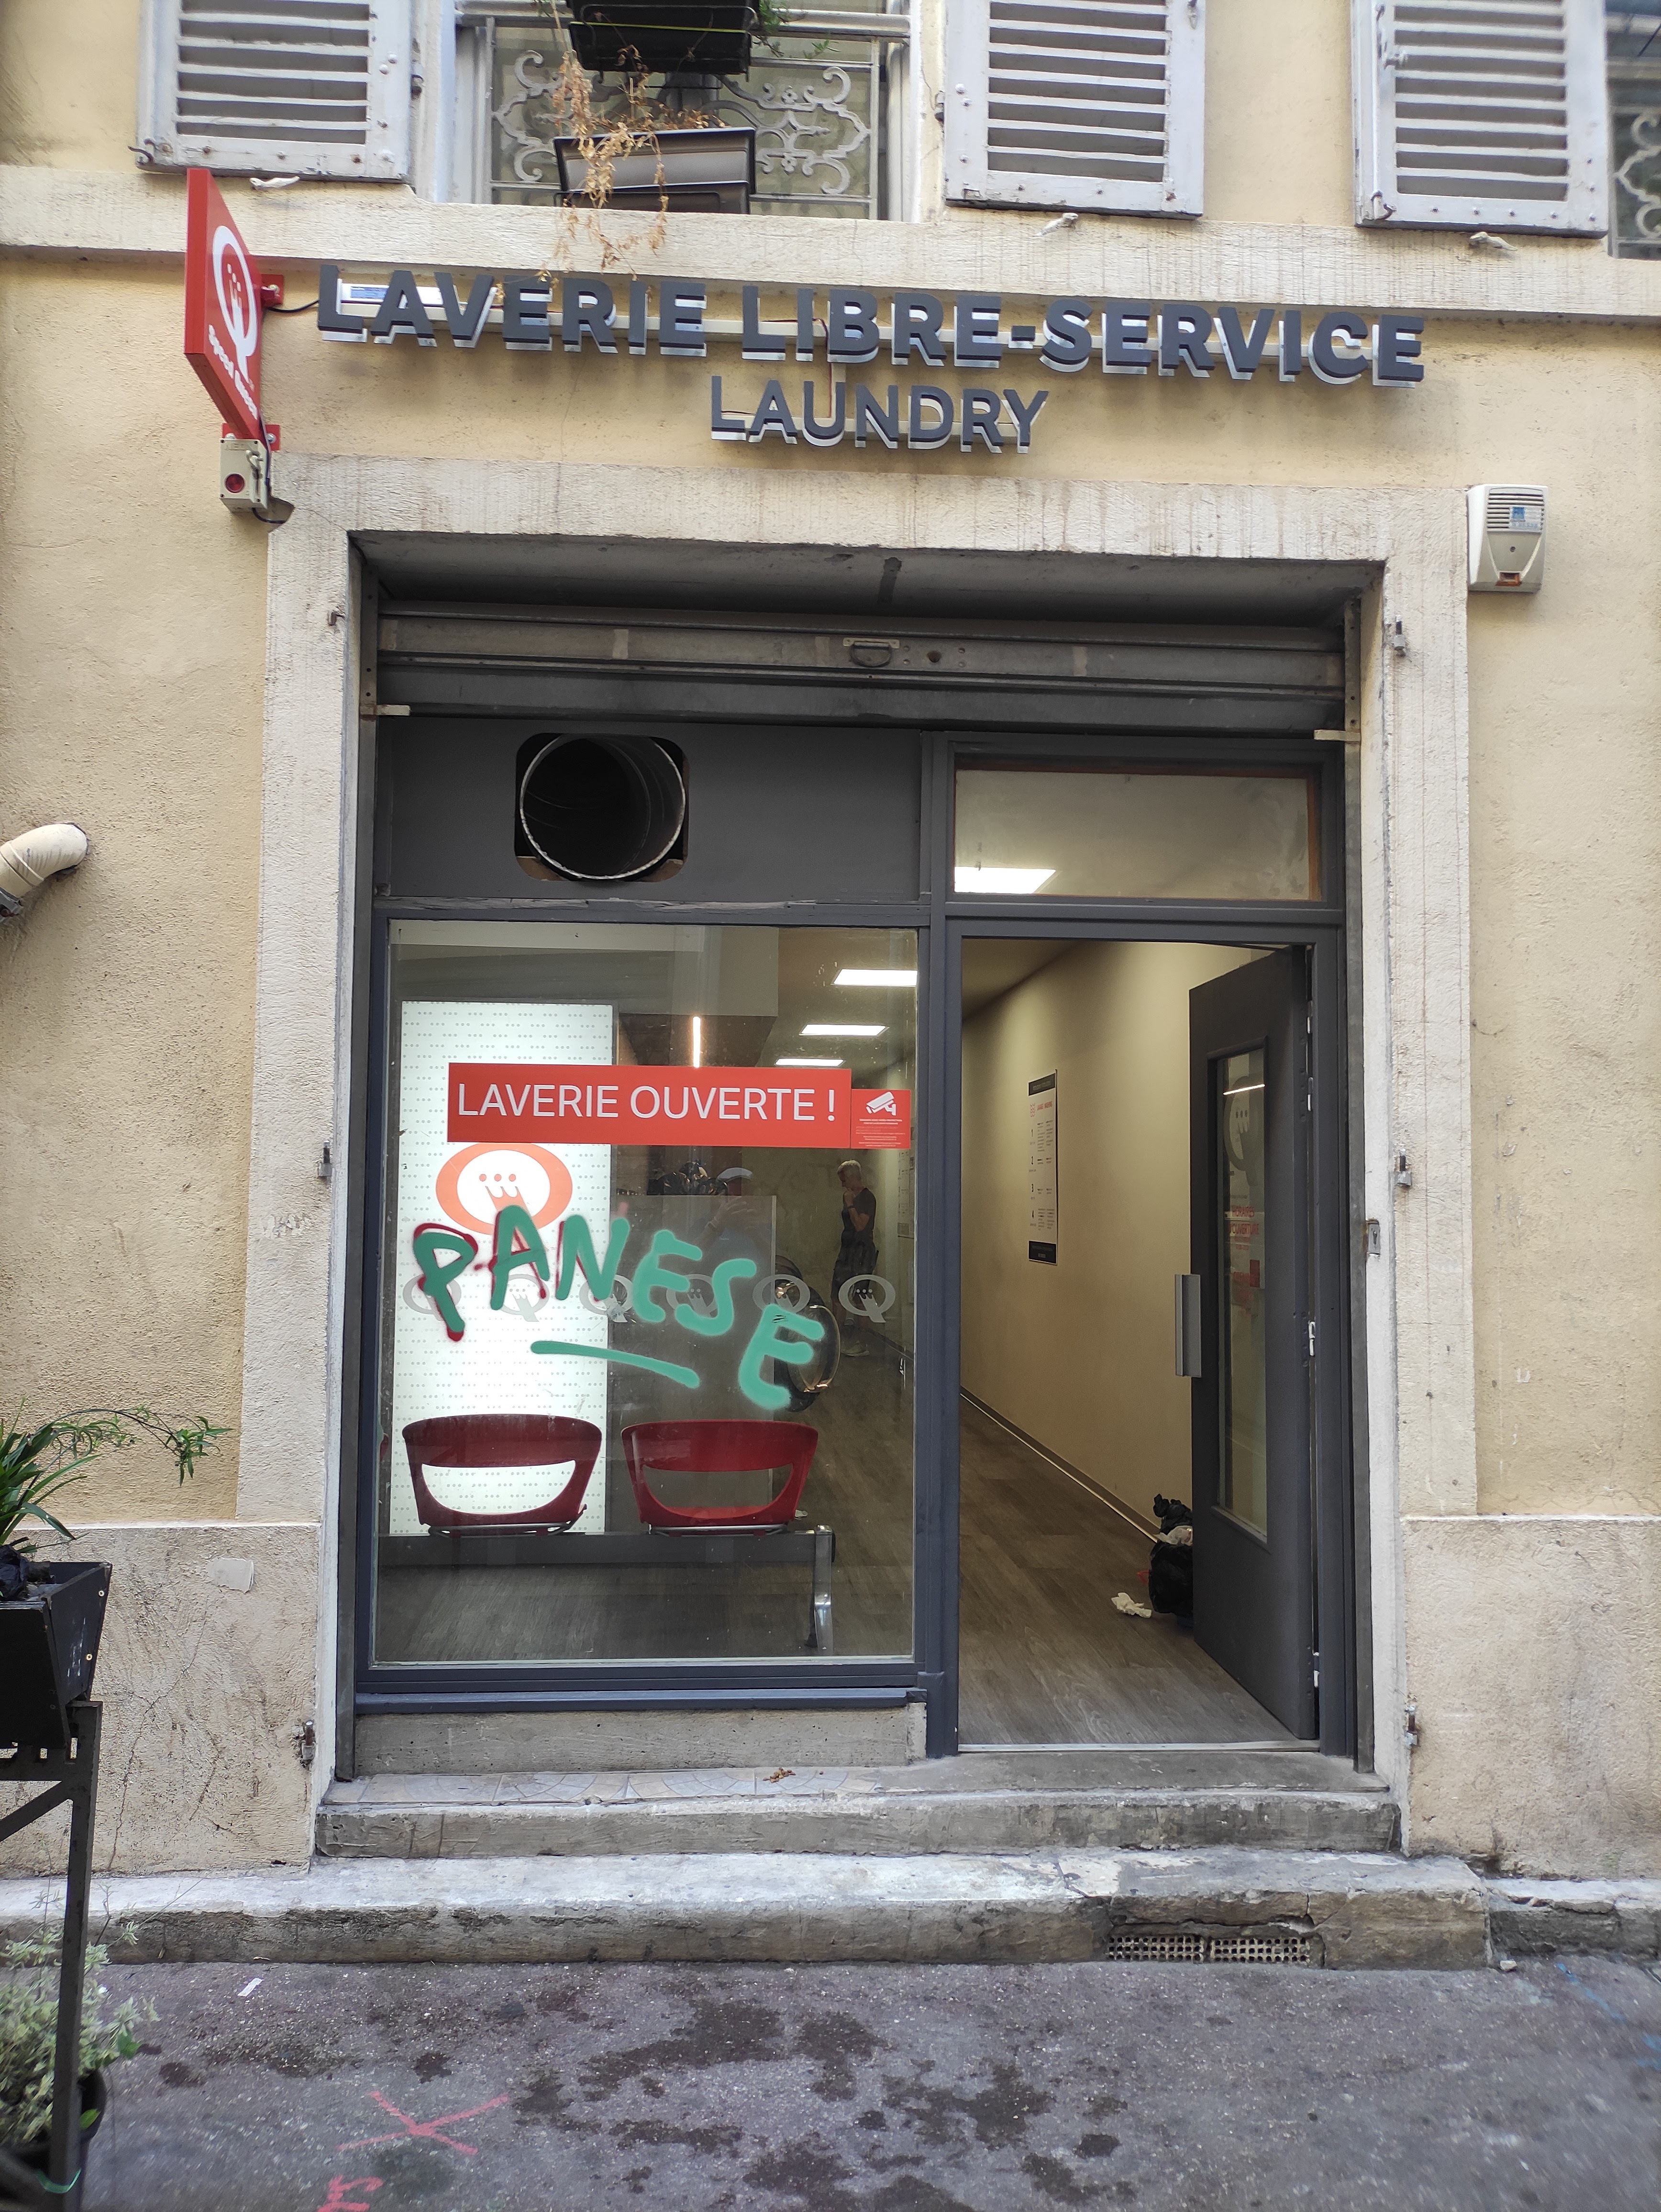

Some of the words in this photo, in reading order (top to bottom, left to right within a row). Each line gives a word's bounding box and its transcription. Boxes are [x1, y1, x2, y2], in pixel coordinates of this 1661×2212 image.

[318, 264, 707, 356] LAVERIE
[742, 285, 1425, 388] LIBRE-SERVICE
[710, 376, 1049, 454] LAUNDRY
[457, 1083, 619, 1118] LAVERIE
[630, 1085, 815, 1121] OUVERTE
